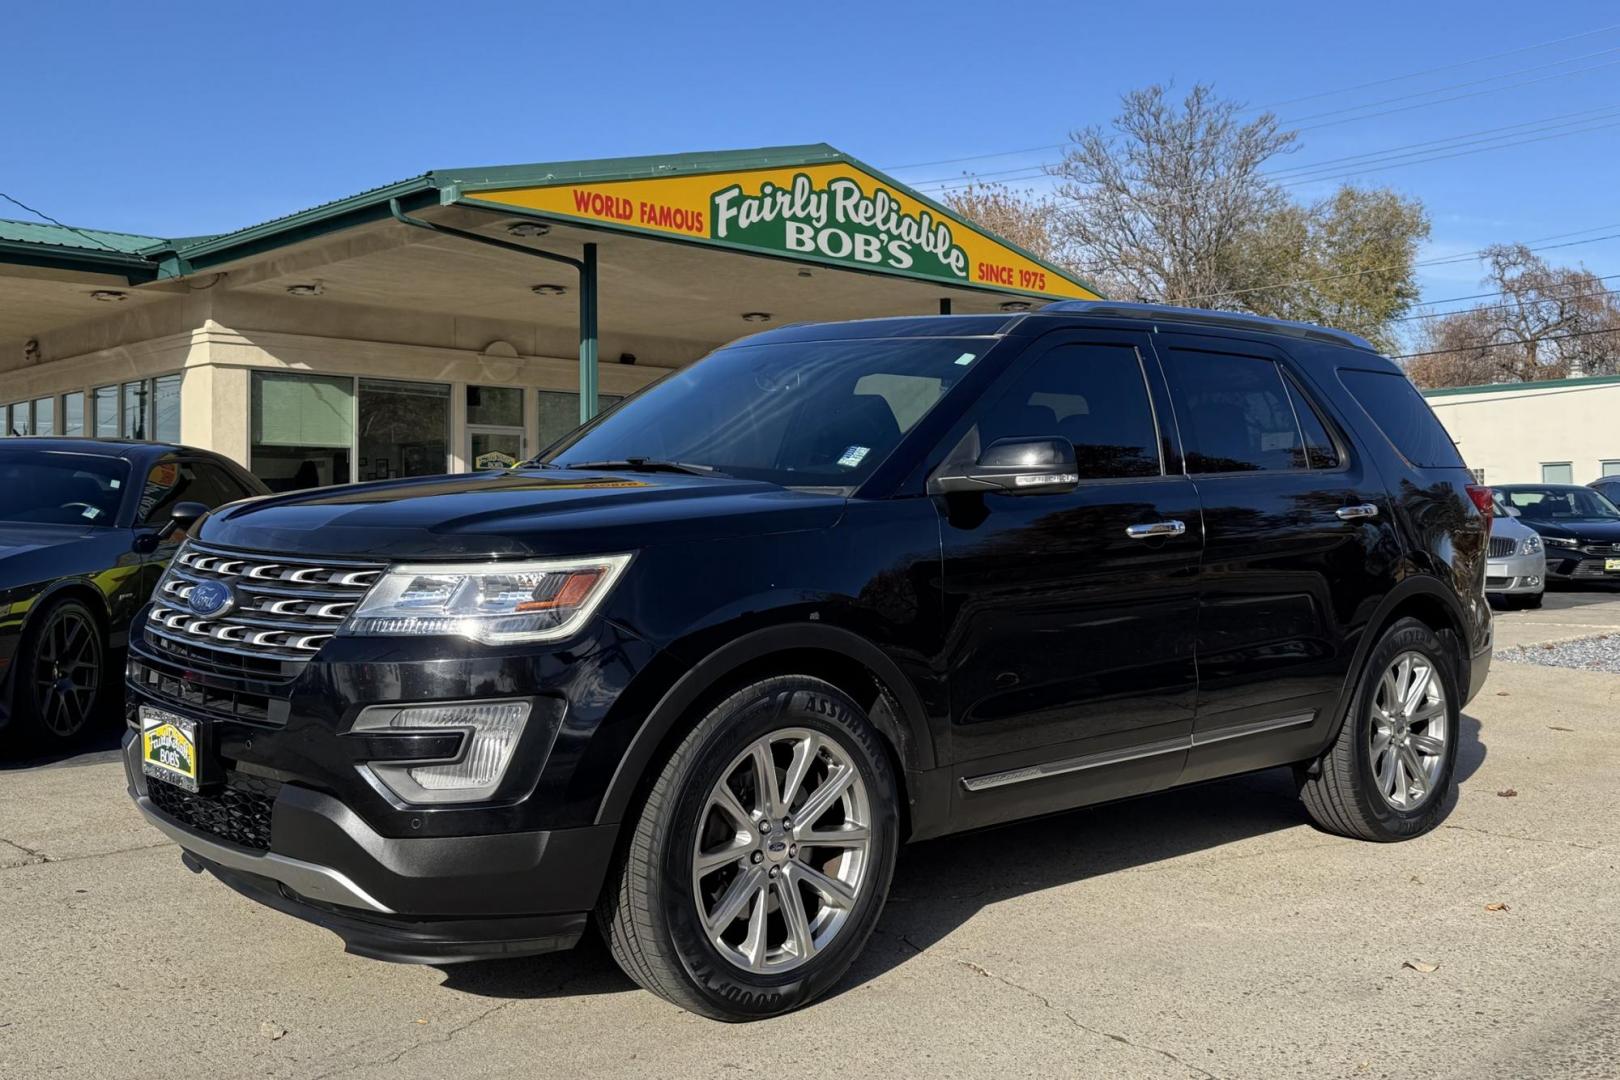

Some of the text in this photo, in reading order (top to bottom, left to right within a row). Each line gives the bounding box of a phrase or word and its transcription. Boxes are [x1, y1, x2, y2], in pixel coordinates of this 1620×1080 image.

[572, 189, 704, 233] WORLD FAMOUS
[714, 176, 967, 277] Fairly Reliable
[785, 221, 914, 269] BOB'S
[978, 262, 1046, 291] SINCE 1975
[190, 586, 219, 608] Ford
